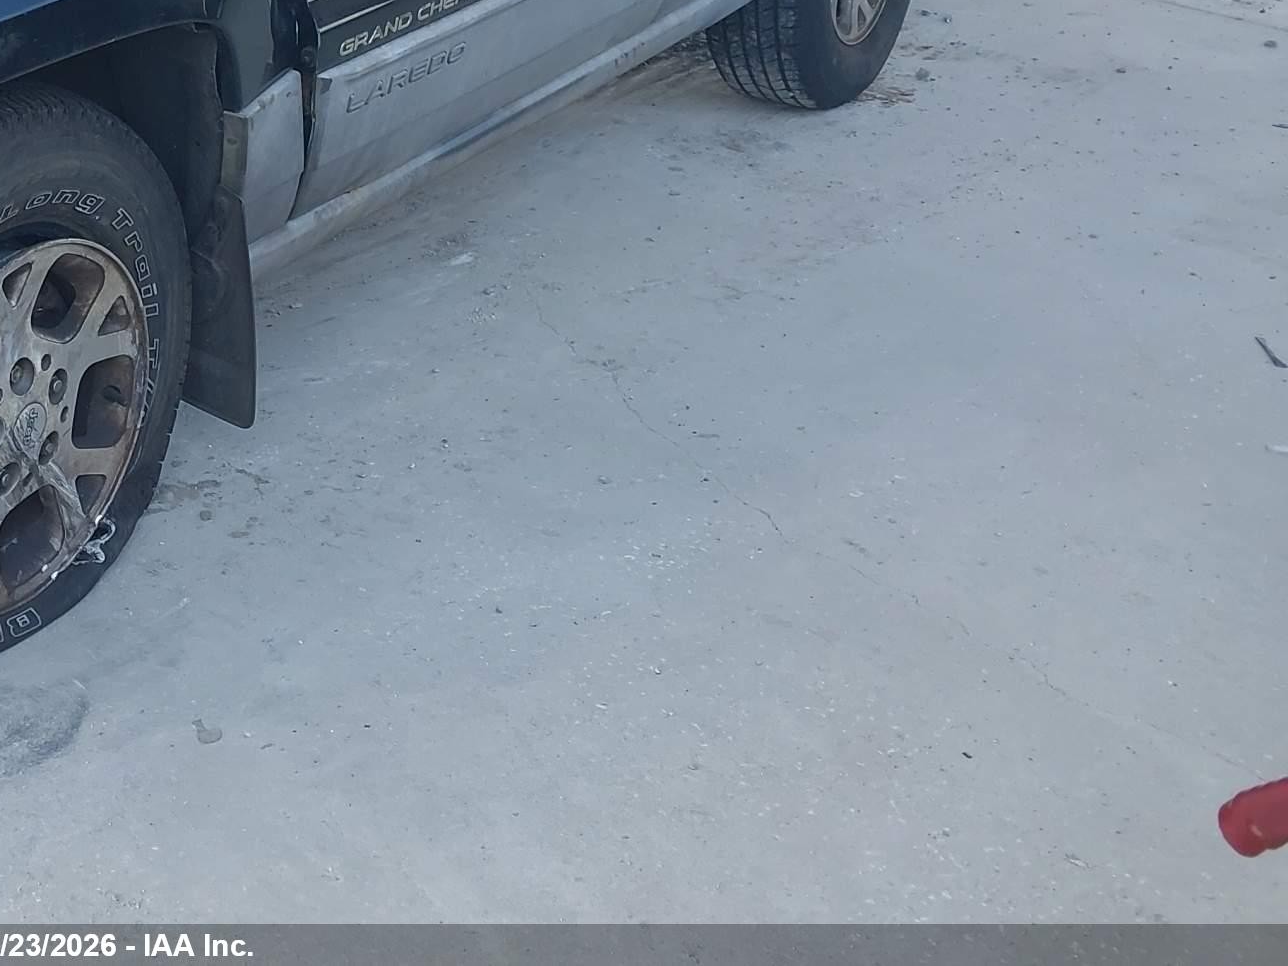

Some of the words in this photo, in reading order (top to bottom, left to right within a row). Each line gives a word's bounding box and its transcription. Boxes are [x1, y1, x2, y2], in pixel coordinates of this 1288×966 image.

[339, 11, 413, 56] GRAND
[346, 41, 467, 115] LAREDO
[112, 207, 159, 318] Trail
